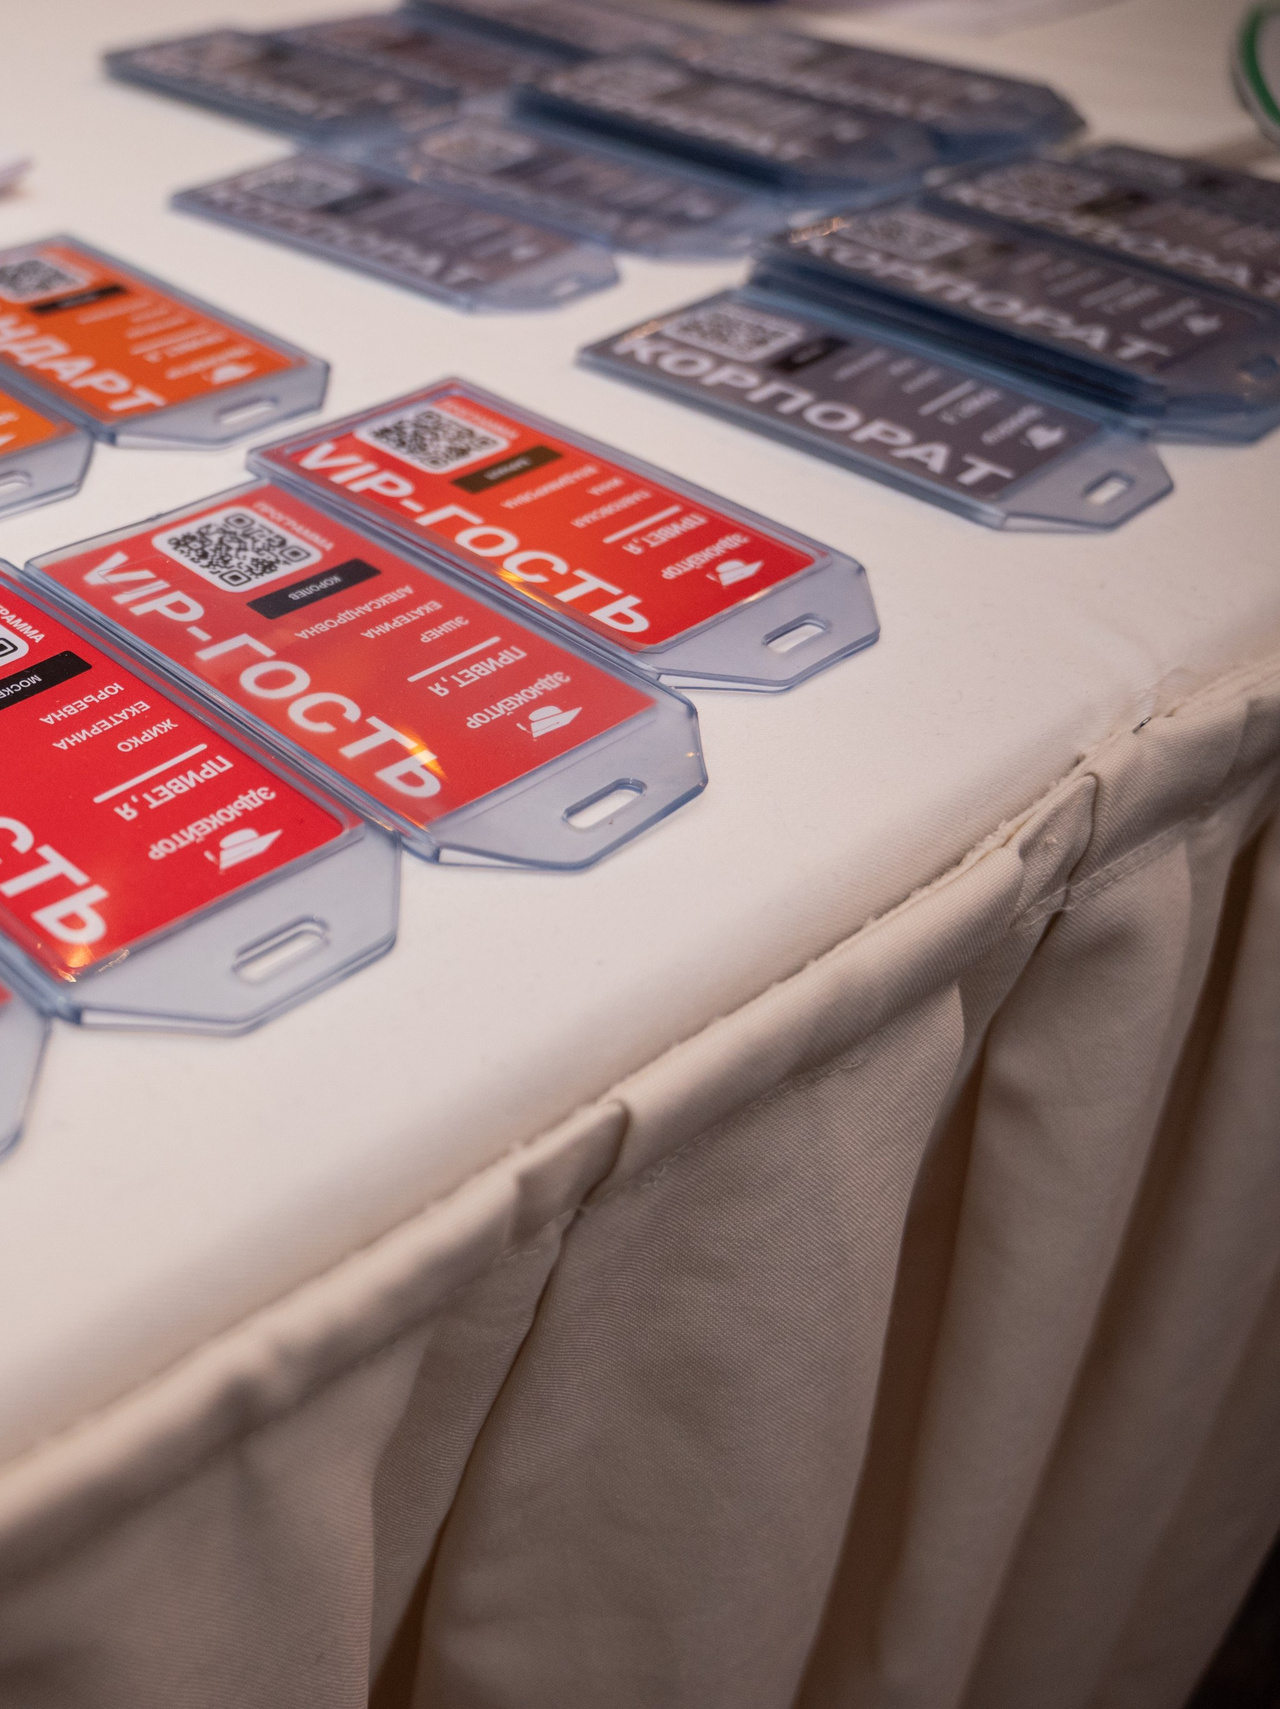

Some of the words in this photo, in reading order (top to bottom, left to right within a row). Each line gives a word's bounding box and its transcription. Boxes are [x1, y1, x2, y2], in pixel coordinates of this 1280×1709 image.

[801, 236, 1173, 360] КОРПОРАТ
[614, 337, 1015, 487] КОРПОРАТ
[299, 442, 650, 633] VIP-ГОСТЬ
[622, 537, 642, 555] Я
[660, 532, 751, 580] ЭДЬЮКЕЙТОР
[287, 574, 342, 601] КОРОЛЕВ
[294, 584, 414, 640] АЛЕКСАНДРОВНА
[360, 600, 443, 640] ЕКАТЕРИНА
[420, 616, 469, 643] ЭШНЕР
[83, 552, 442, 799] VIP-ГОСТЬ
[427, 681, 448, 697] Я
[448, 646, 527, 689] ПРИВЕТ,
[39, 681, 125, 726] ЮРЬЕВНА
[465, 671, 571, 729] ЭДЬЮКЕЙТОР
[52, 700, 151, 751] ЕКАТЕРИНА
[116, 718, 178, 753] ЖИРКО
[137, 755, 234, 811] ПРИВЕТ,
[114, 801, 138, 821] Я
[147, 786, 276, 861] ЭДЬЮКЕЙТОР
